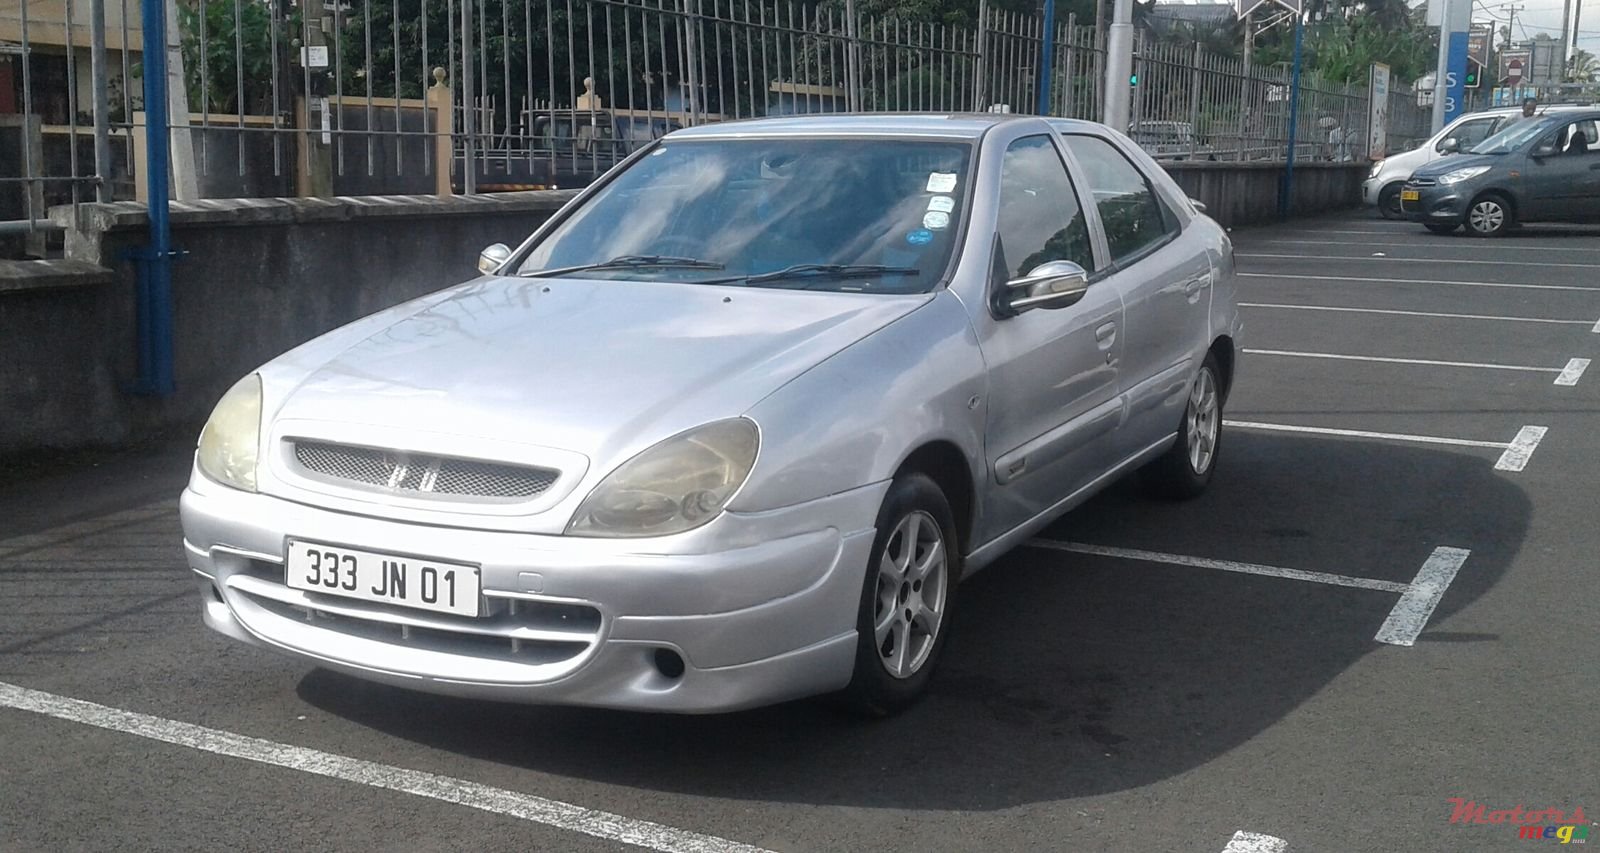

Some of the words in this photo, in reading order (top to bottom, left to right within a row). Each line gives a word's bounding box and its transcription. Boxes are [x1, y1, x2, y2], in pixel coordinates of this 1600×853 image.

[306, 549, 358, 591] 333
[371, 560, 407, 600] JN
[421, 566, 456, 608] 01
